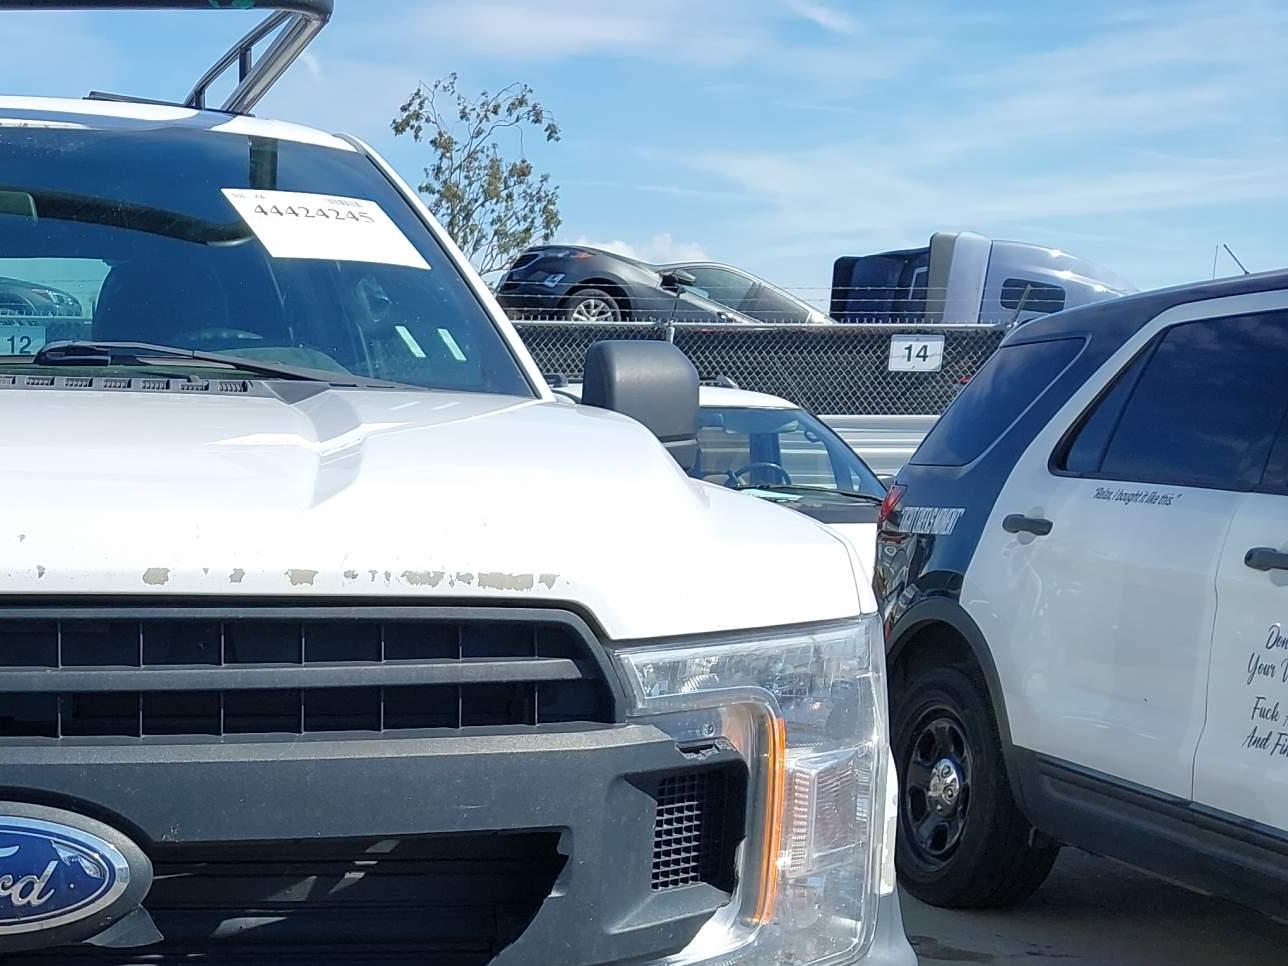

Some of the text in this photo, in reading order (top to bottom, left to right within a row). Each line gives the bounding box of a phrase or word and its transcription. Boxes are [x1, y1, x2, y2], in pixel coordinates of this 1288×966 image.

[254, 204, 375, 223] 44424245
[7, 335, 32, 354] 12
[904, 343, 929, 362] 14
[1246, 652, 1276, 686] Your
[1251, 696, 1280, 722] Fuck
[1242, 725, 1273, 750] And
